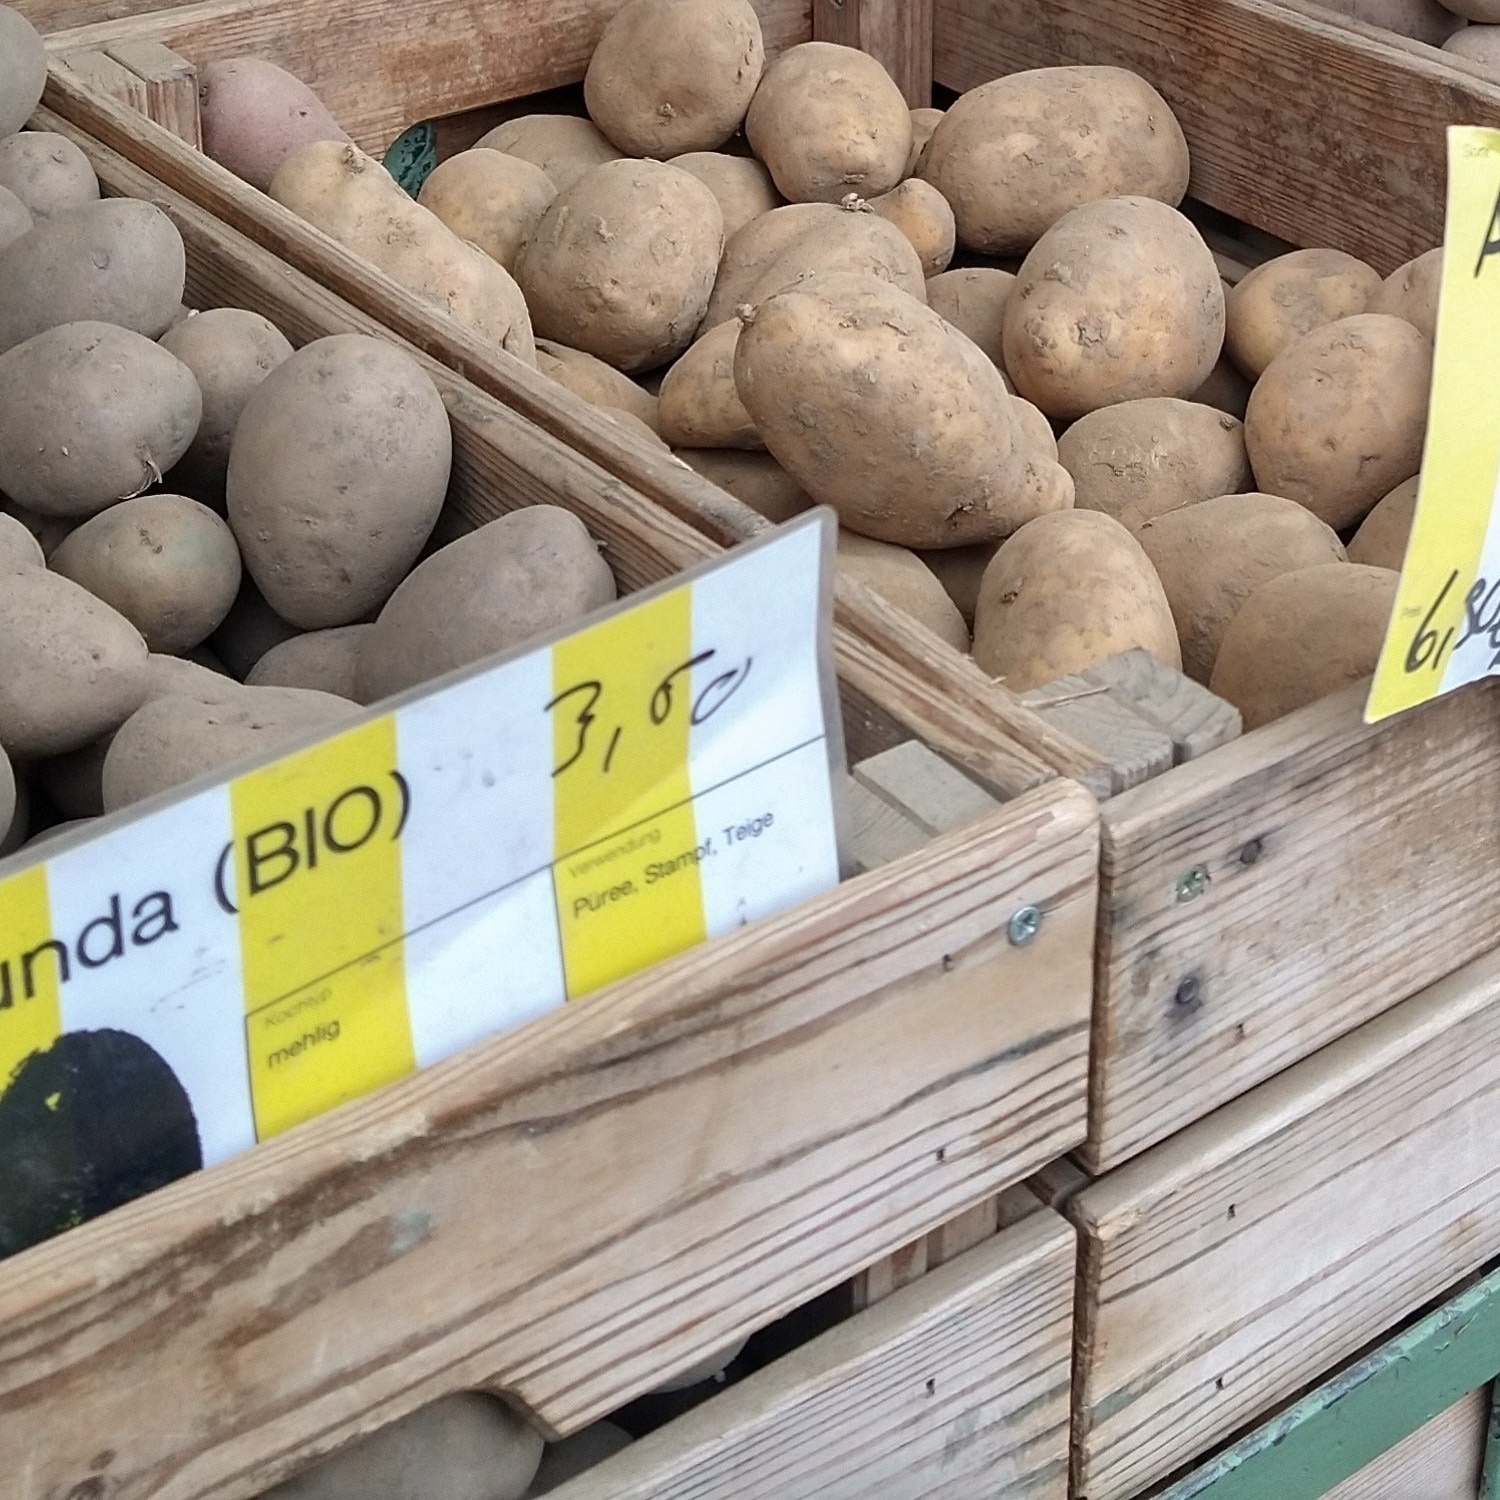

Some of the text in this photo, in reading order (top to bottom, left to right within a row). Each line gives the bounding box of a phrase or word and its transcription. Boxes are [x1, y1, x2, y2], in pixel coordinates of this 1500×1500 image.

[213, 769, 412, 915] (BIO)
[568, 828, 663, 878] Verwendung
[572, 811, 775, 920] Püree, Stampf, Teige
[266, 1019, 341, 1070] mehlig
